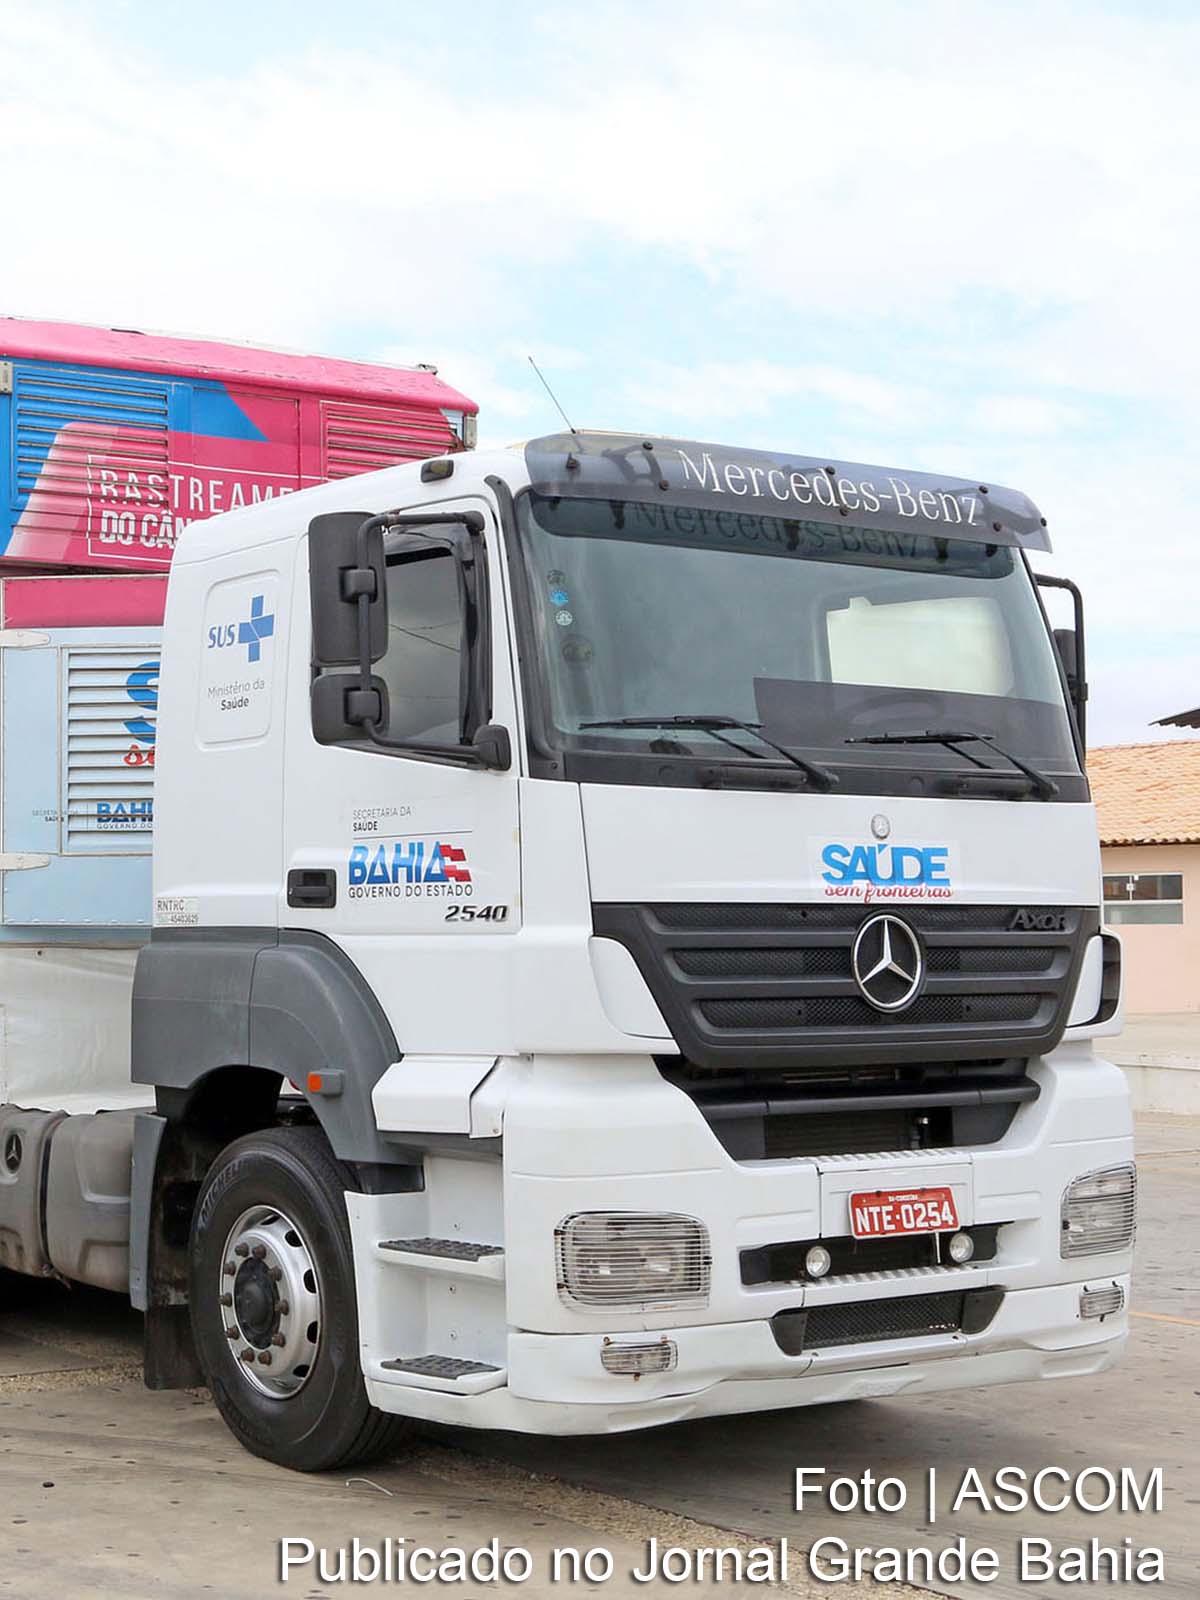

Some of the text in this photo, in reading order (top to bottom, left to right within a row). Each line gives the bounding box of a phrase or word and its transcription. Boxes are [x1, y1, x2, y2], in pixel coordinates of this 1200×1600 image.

[677, 449, 981, 527] Mercedes-Benz
[101, 509, 136, 544] DO
[208, 624, 236, 648] SUS
[221, 698, 249, 711] Saúde
[353, 806, 412, 820] SECRETARIA DA
[353, 820, 378, 832] SAÚDE
[349, 841, 449, 885] BAHIA
[821, 843, 950, 887] SAÚDE
[349, 884, 473, 899] GOVERNO DO ESTADO
[824, 883, 953, 904] sem fronteiras
[445, 905, 508, 922] 2540
[1007, 909, 1072, 932] Axor
